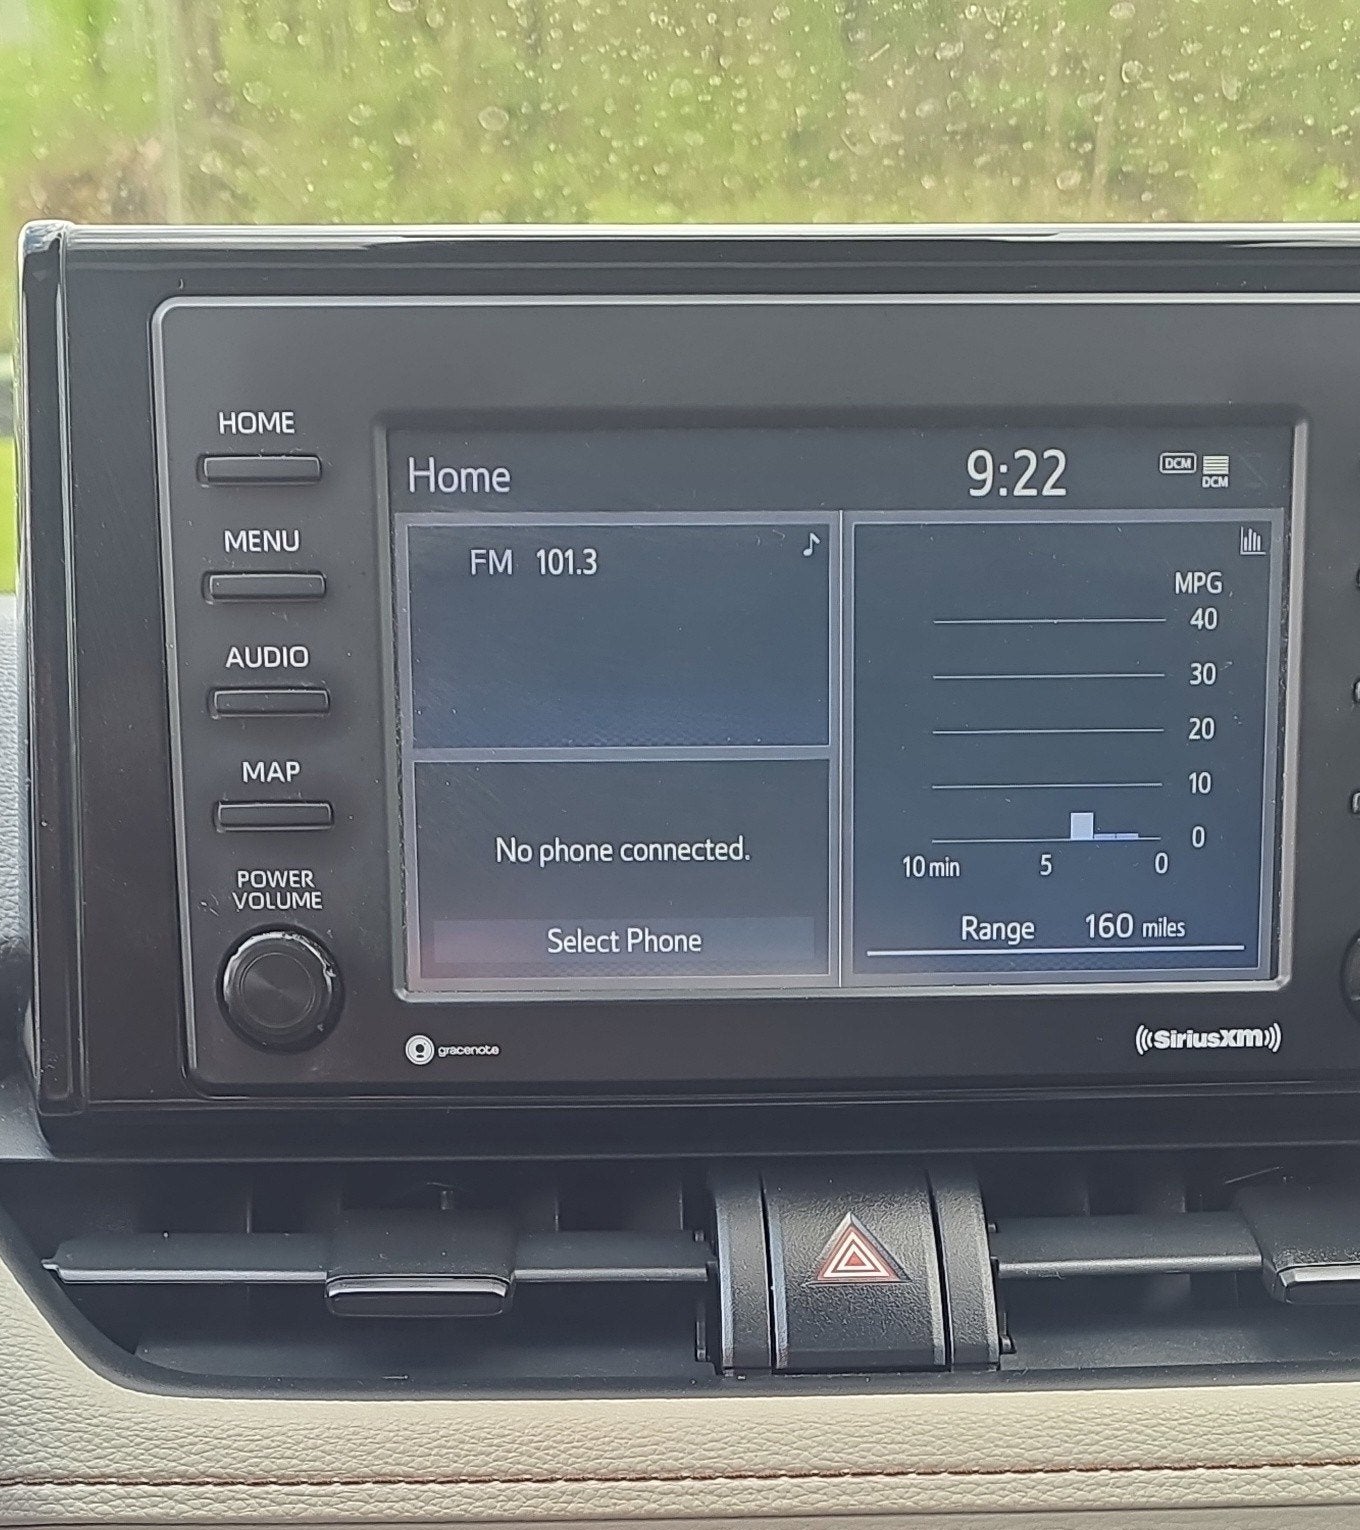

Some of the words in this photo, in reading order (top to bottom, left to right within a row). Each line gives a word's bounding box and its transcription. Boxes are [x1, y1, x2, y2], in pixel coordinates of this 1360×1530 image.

[219, 411, 295, 434] HOME
[408, 456, 511, 493] Home
[967, 448, 1067, 497] 9:22
[1165, 457, 1192, 469] DCM
[1202, 475, 1229, 488] DCM
[224, 529, 300, 553] MENU
[470, 549, 513, 575] FM
[536, 548, 597, 575] 101.3
[1175, 571, 1223, 595] MPG
[1189, 607, 1218, 630] 40
[225, 646, 309, 669] AUDIO
[1189, 662, 1216, 685] 30
[1188, 717, 1215, 740] 20
[242, 761, 300, 783] MAP
[1188, 771, 1211, 794] 10
[1192, 825, 1205, 848] 0
[496, 836, 533, 863] No
[539, 836, 613, 868] phone
[620, 834, 750, 862] connected.
[903, 855, 926, 878] 10
[929, 856, 960, 877] min
[1040, 854, 1052, 876] 5
[1154, 852, 1168, 874] 0
[237, 870, 315, 888] POWER
[231, 891, 323, 910] VOLUME
[961, 915, 1035, 945] Range
[1085, 912, 1134, 939] 160
[1142, 916, 1186, 938] miles
[547, 927, 621, 954] Select
[627, 927, 702, 953] Phone
[437, 1044, 501, 1058] gracenote
